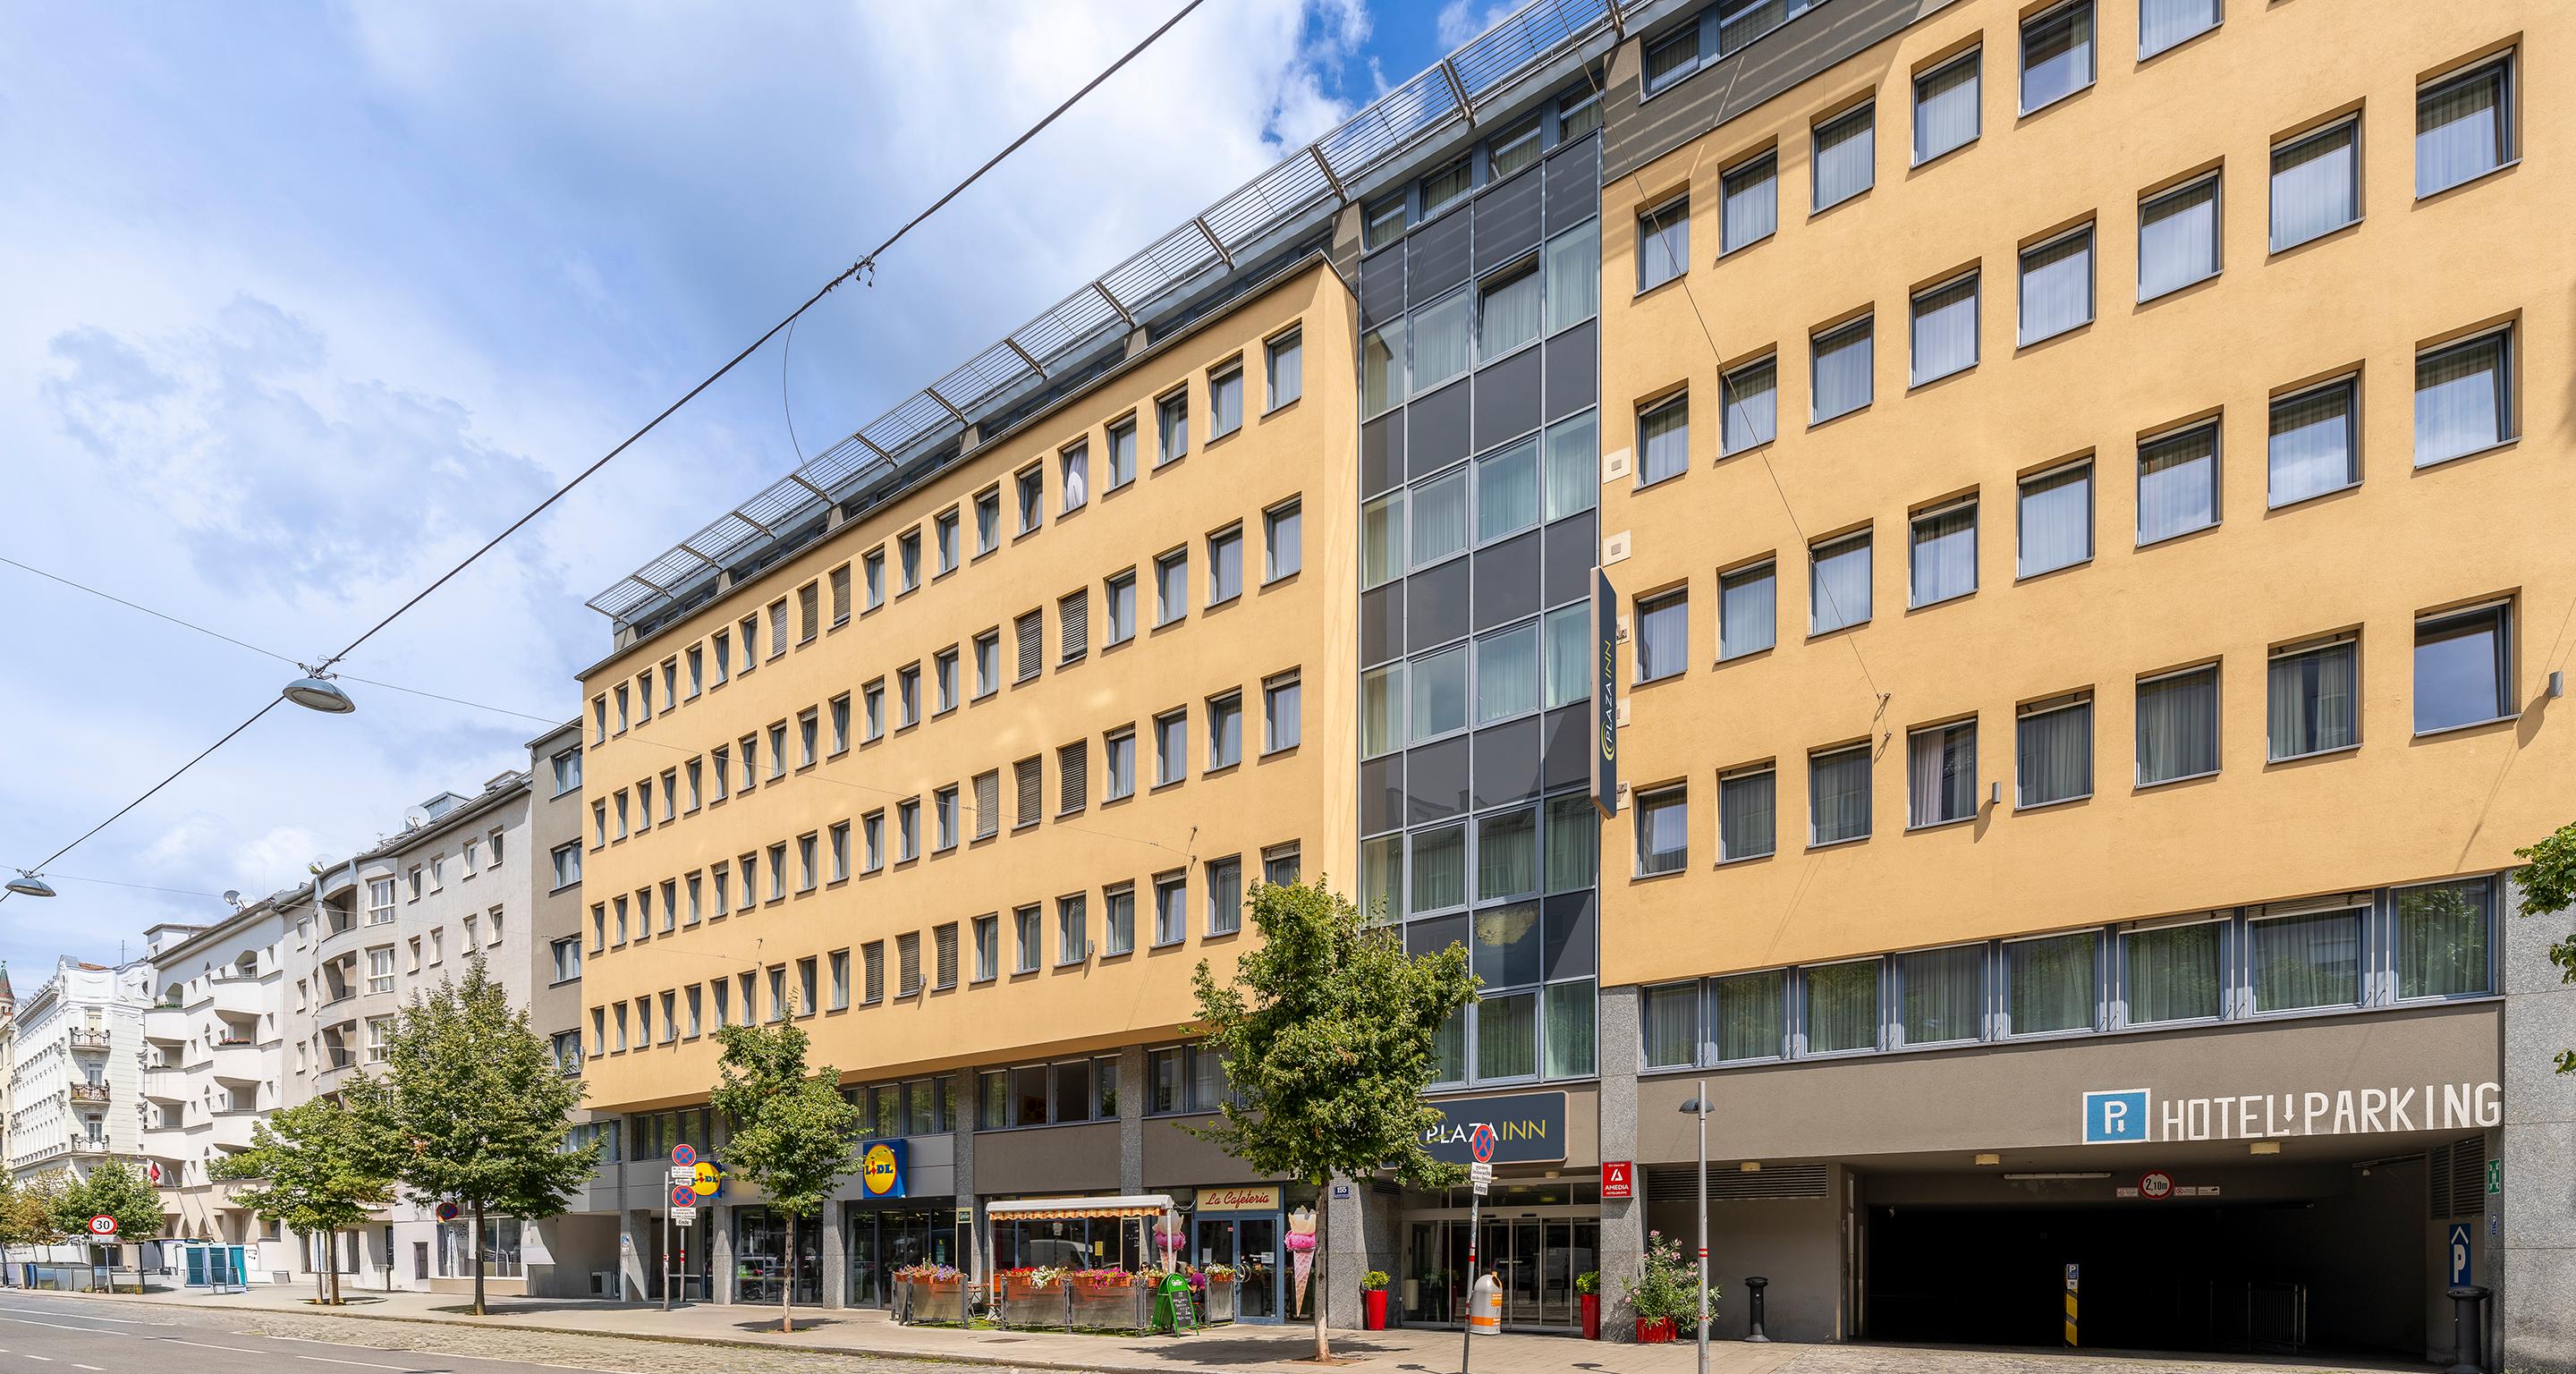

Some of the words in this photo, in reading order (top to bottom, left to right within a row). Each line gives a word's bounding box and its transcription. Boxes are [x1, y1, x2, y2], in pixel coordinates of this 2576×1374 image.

[1605, 683, 1613, 743] PLAZA
[2104, 1100, 2128, 1134] P
[2163, 1094, 2290, 1141] HOTEL
[2304, 1081, 2502, 1135] PARKING
[1503, 1119, 1546, 1141] INN
[1205, 1192, 1221, 1205] La
[1224, 1190, 1270, 1209] Cafeteria
[96, 1220, 110, 1230] 30
[2453, 1244, 2466, 1284] P
